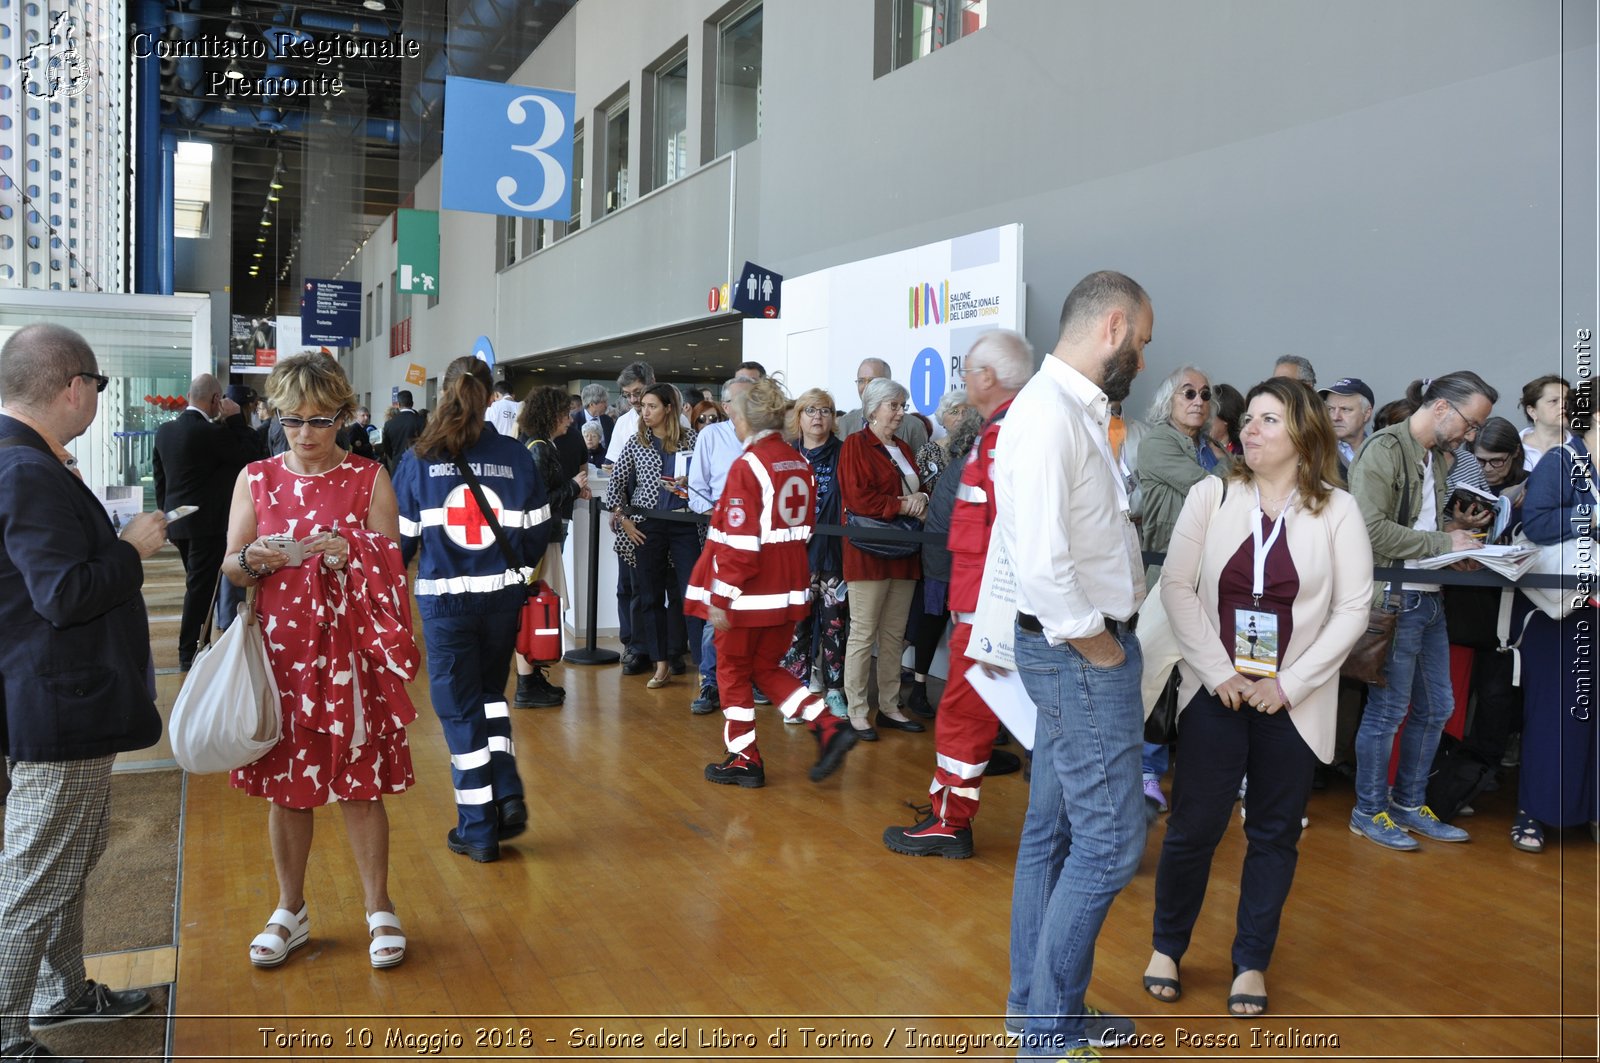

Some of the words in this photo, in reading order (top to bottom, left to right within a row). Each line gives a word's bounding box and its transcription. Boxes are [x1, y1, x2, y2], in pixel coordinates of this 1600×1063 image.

[496, 95, 566, 212] 3
[950, 291, 971, 303] SALONE
[950, 296, 1000, 312] INTERNAZIONALE
[950, 312, 960, 321] DEL
[960, 309, 978, 320] LIBRO
[978, 306, 999, 317] TORINO
[429, 463, 456, 477] CROCE
[483, 463, 514, 479] ITALIANA
